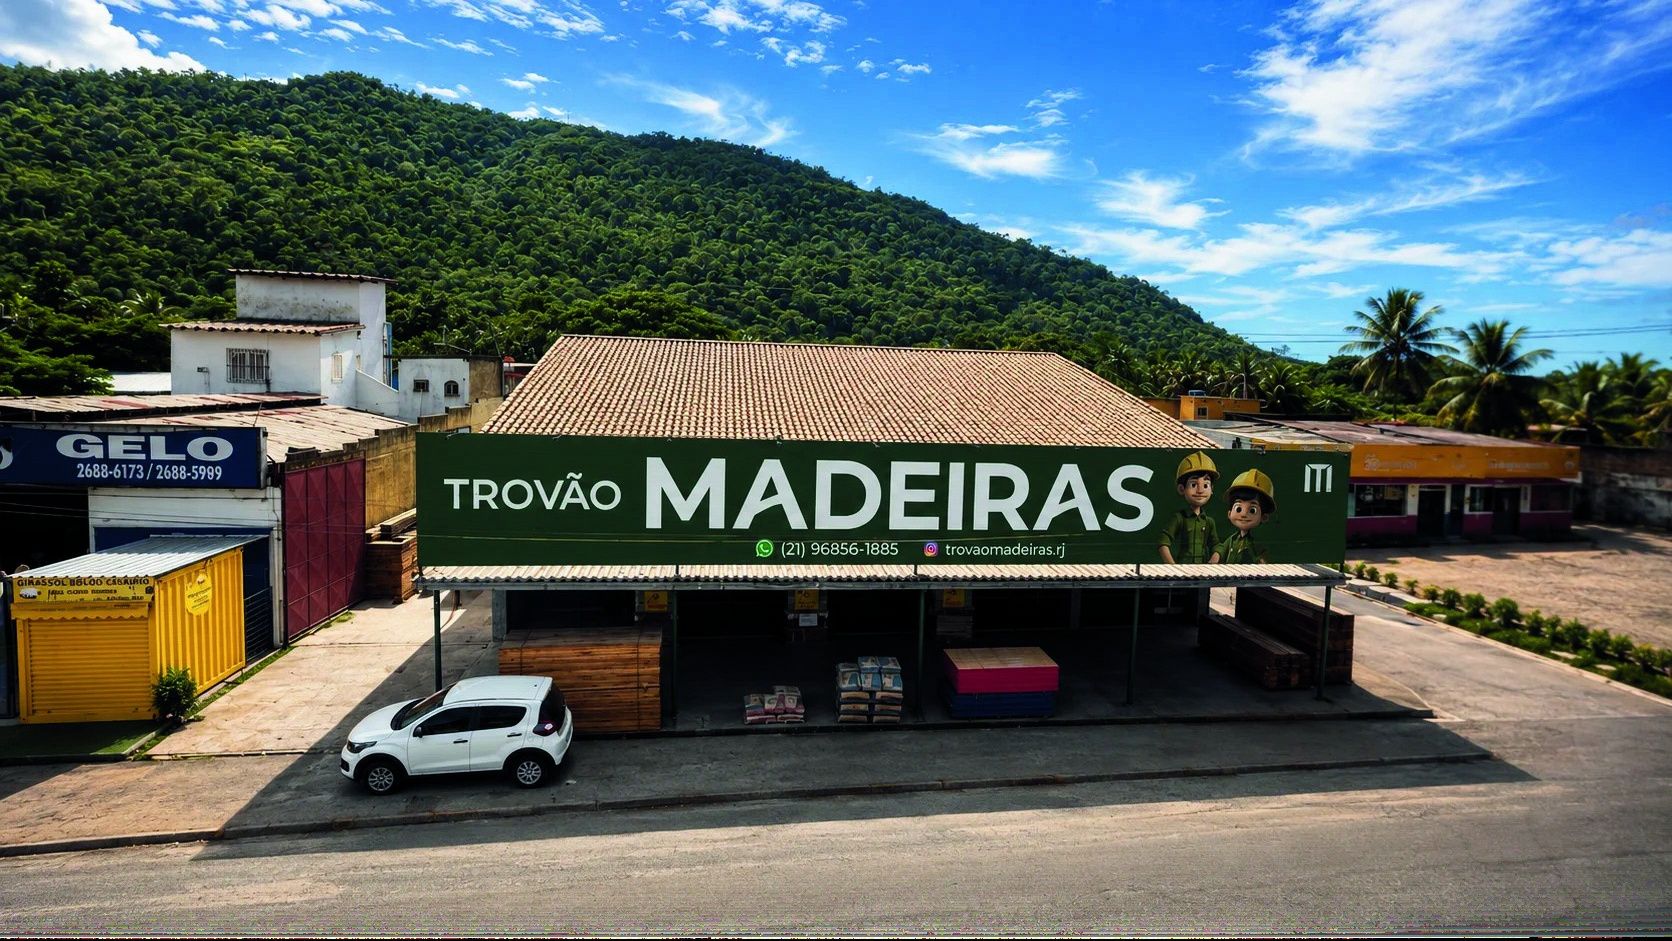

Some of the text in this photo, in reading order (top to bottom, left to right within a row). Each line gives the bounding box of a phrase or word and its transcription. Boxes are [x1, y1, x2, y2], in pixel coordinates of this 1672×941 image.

[56, 433, 234, 462] GELO
[76, 463, 144, 480] 2688-6173
[443, 456, 1154, 533] TROVÃO MADEIRAS
[781, 541, 900, 559] (21) 96856-1885
[945, 542, 1065, 559] trovaomadeiras.rj
